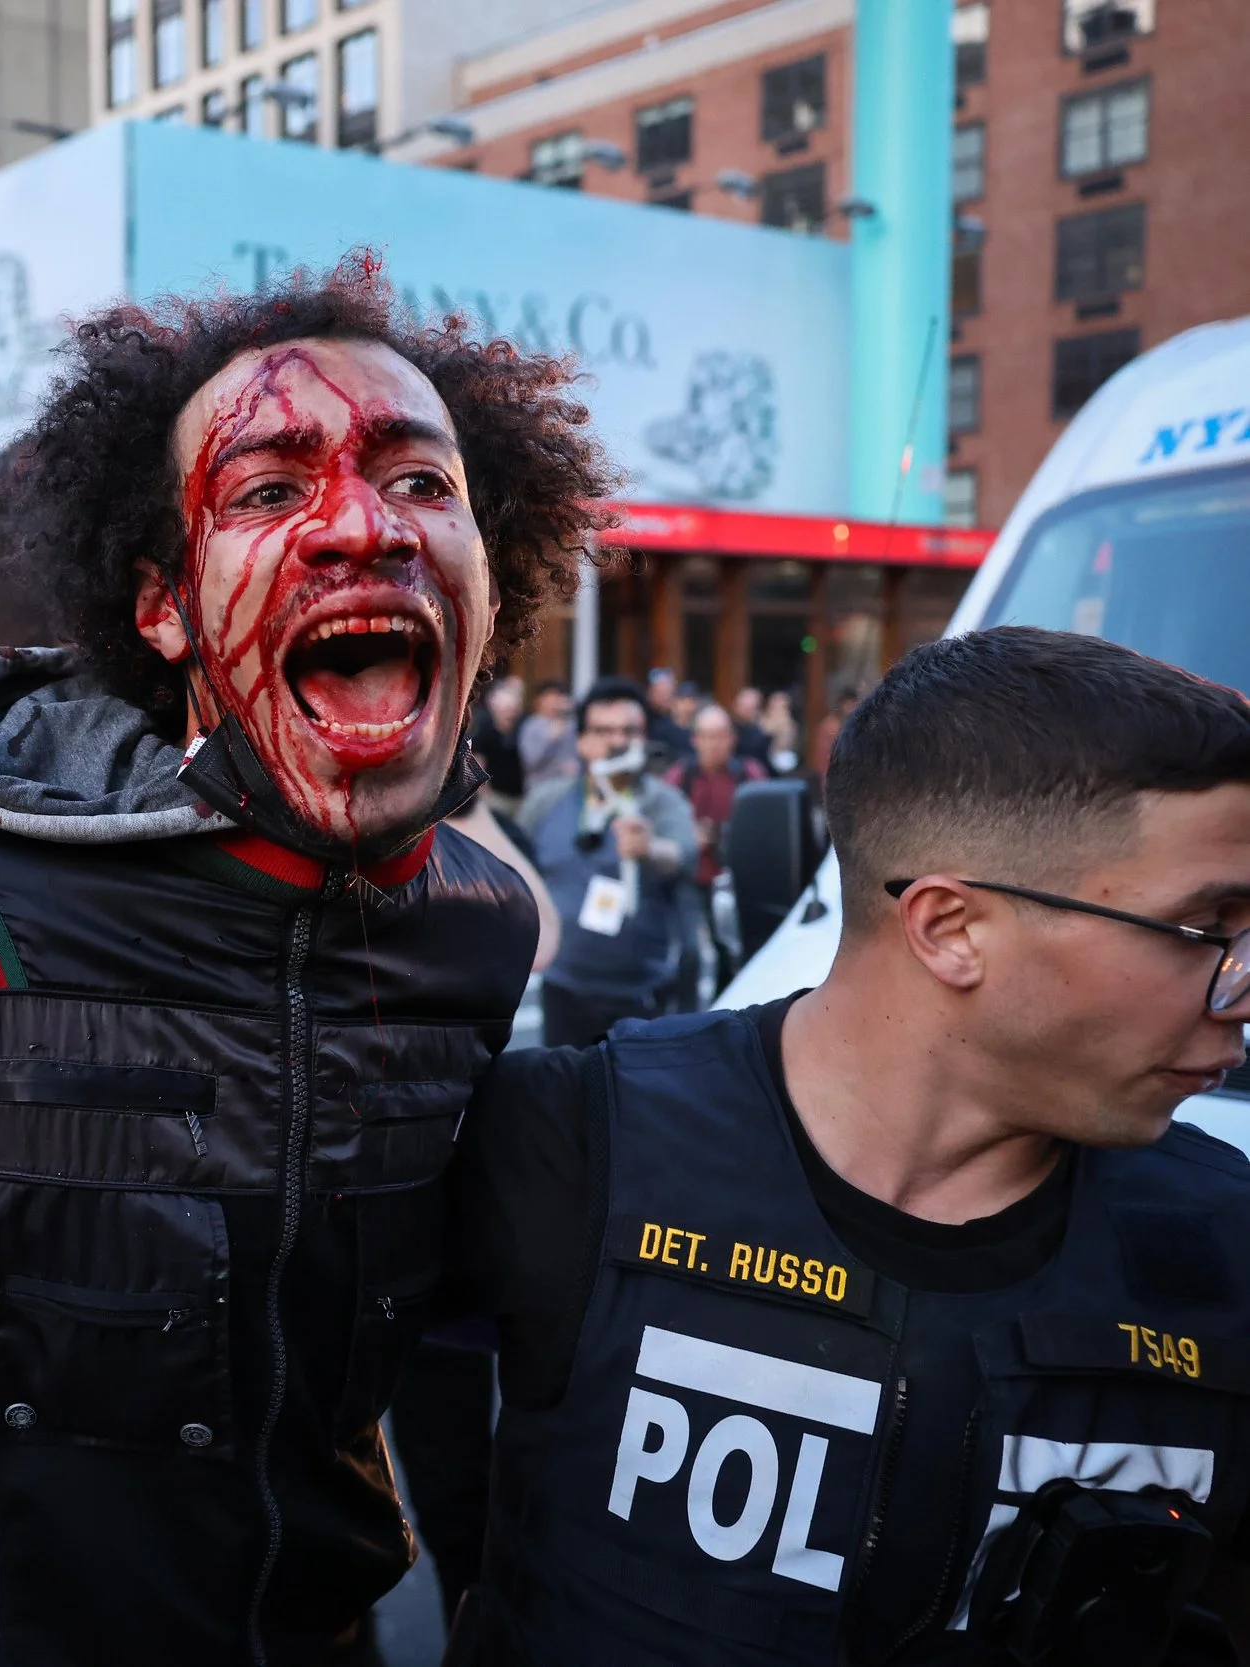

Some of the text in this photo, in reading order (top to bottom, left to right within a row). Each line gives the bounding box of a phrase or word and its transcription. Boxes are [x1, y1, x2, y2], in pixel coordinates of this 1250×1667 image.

[639, 1223, 847, 1302] DET. RUSSO
[1117, 1323, 1201, 1378] 7549
[608, 1386, 845, 1592] POL
